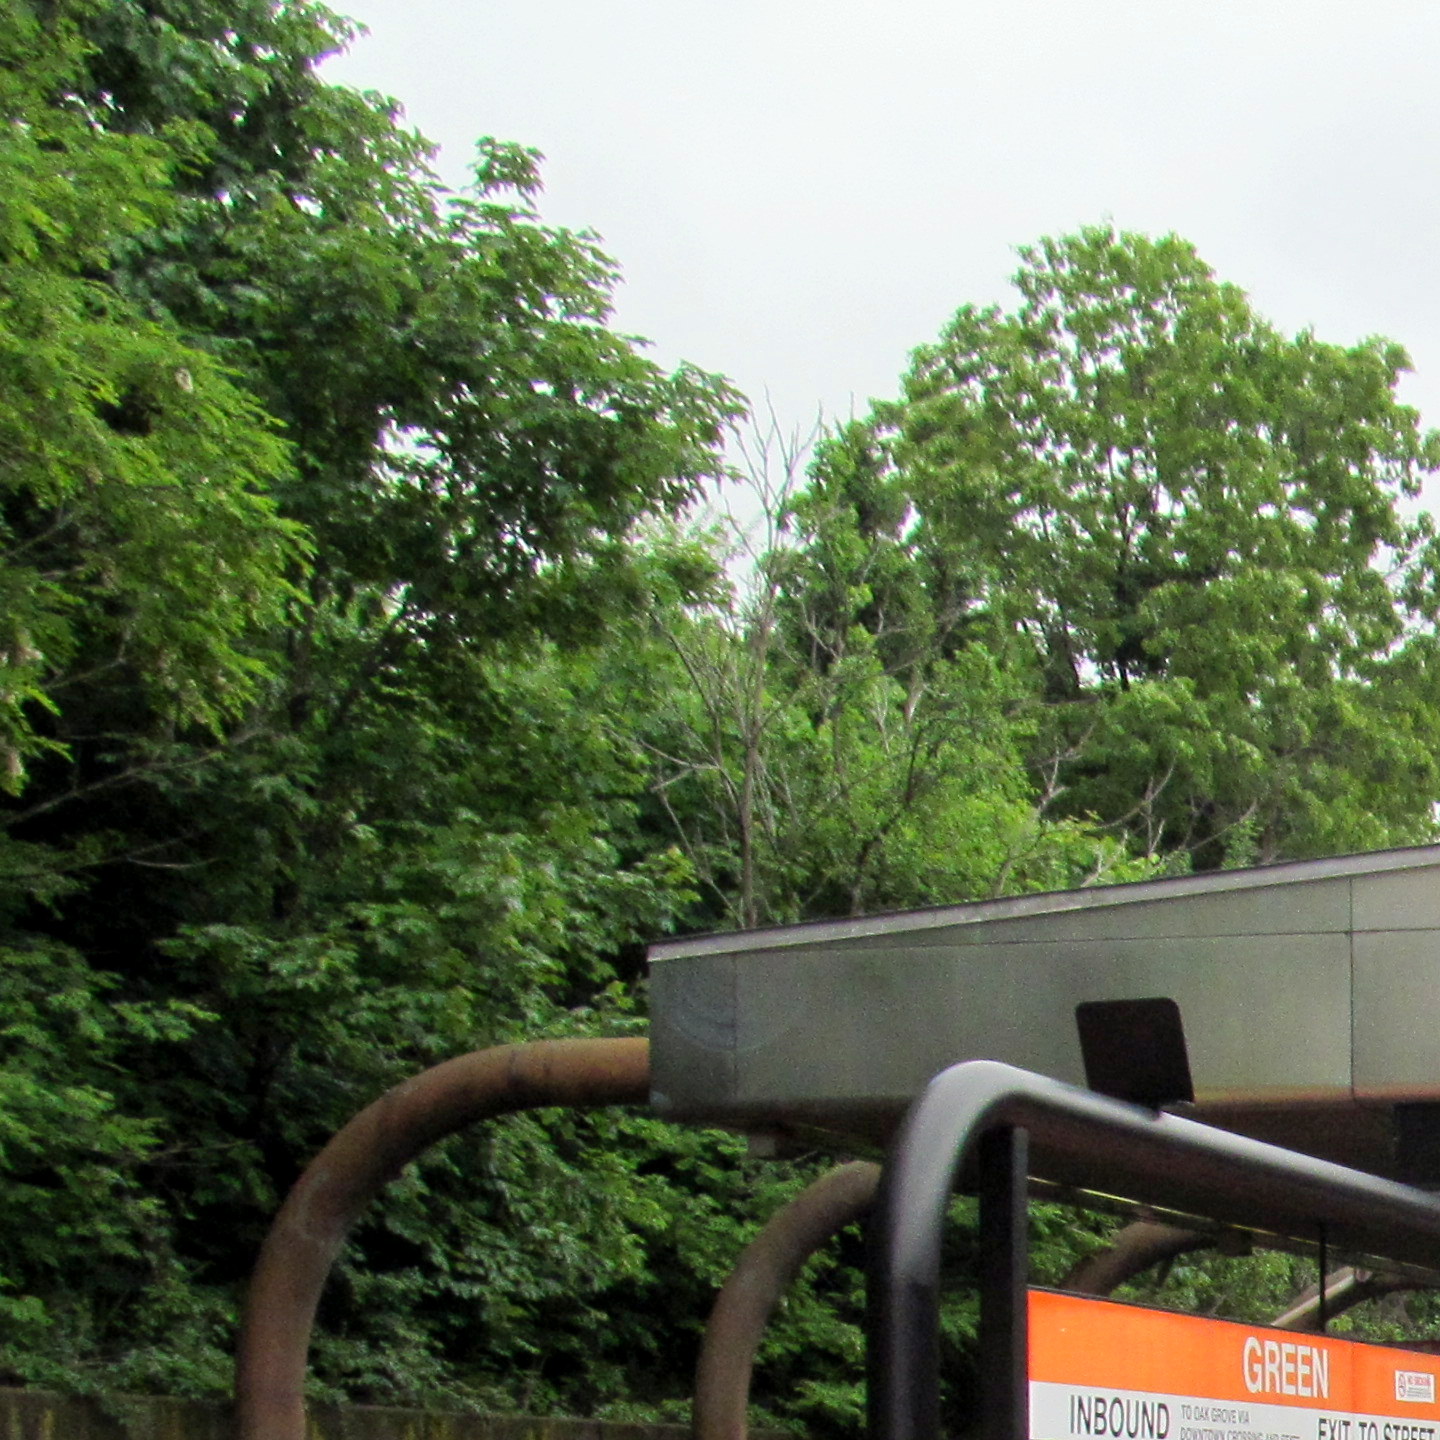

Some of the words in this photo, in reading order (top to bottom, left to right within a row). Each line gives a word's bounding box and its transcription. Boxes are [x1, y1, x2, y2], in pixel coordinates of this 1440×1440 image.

[1242, 1336, 1329, 1399] GREEN
[1070, 1394, 1170, 1440] INBOUND
[1181, 1404, 1192, 1420] TO
[1194, 1405, 1210, 1421] OAK
[1210, 1407, 1236, 1424] GROVE
[1237, 1409, 1250, 1424] VIA
